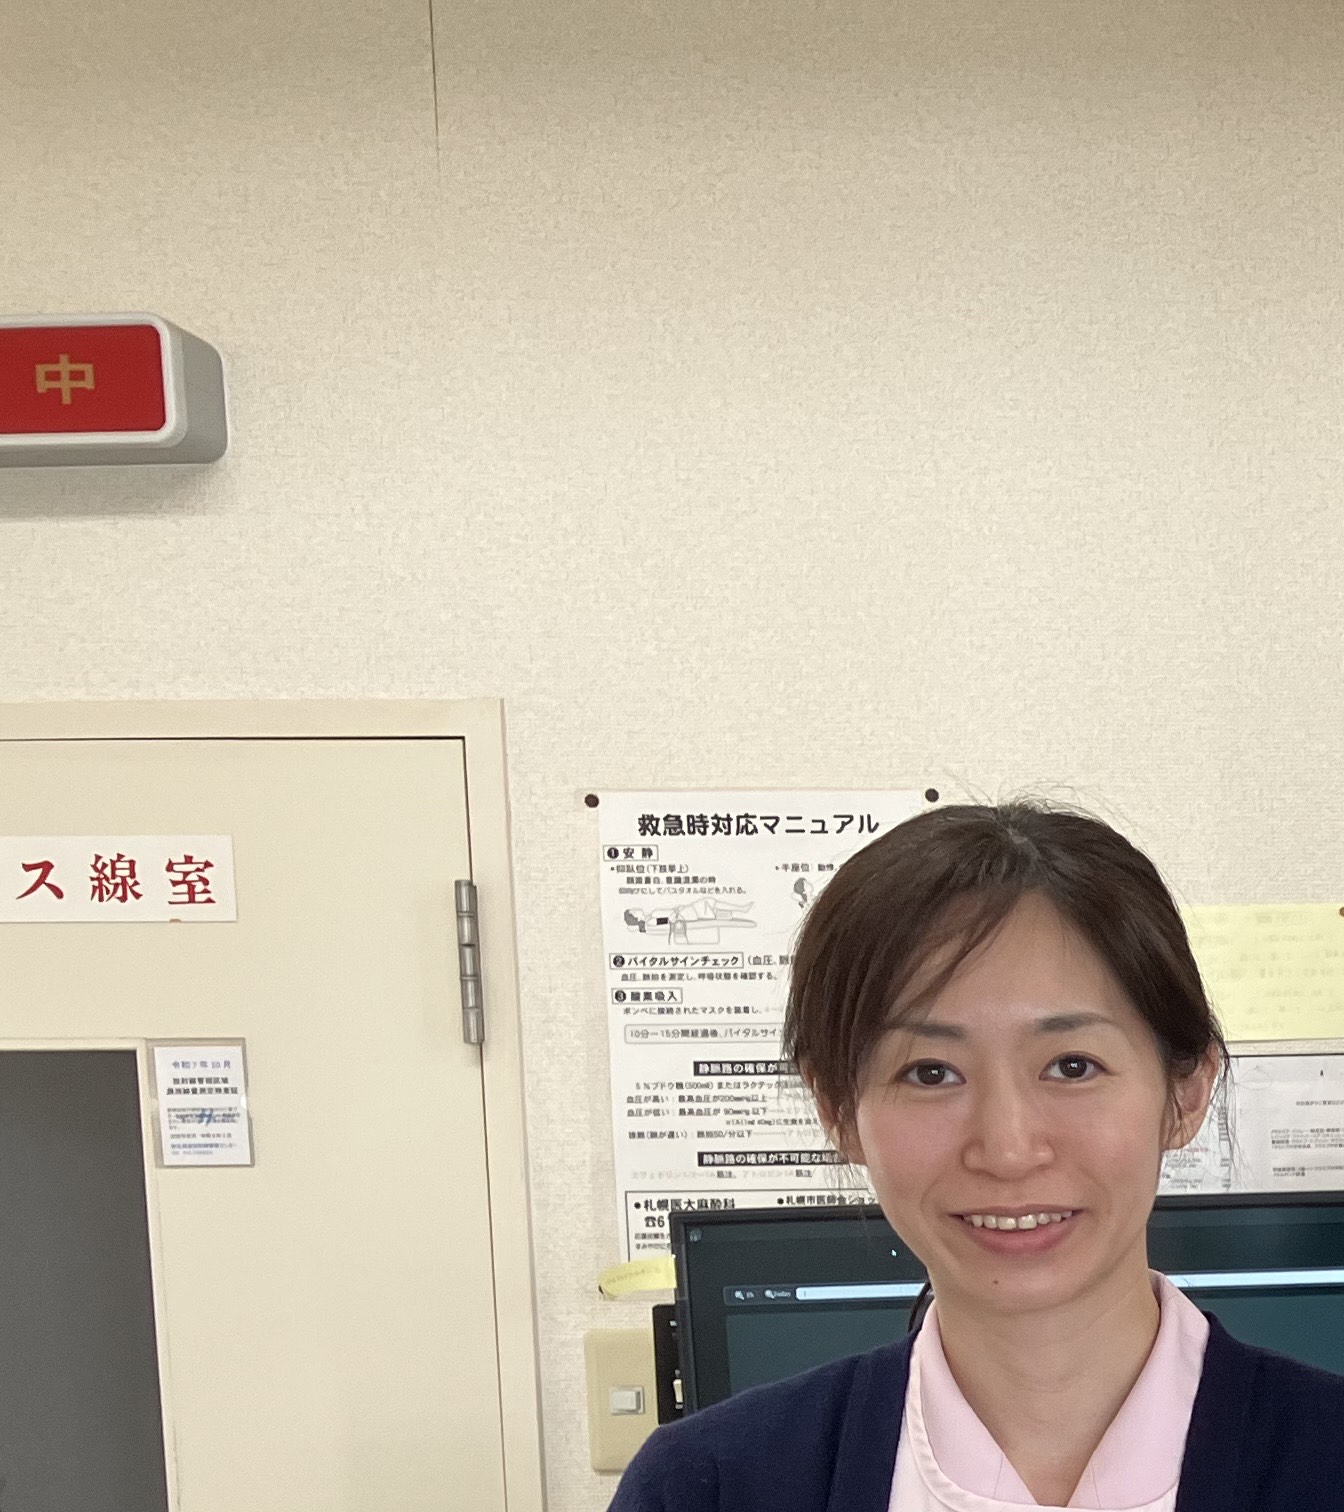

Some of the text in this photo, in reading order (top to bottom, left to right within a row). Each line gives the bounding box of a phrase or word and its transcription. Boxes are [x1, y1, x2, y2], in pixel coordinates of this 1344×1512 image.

[35, 354, 96, 405] 中
[637, 812, 880, 838] 救急時対応マニュアル
[15, 855, 217, 907] ス線室
